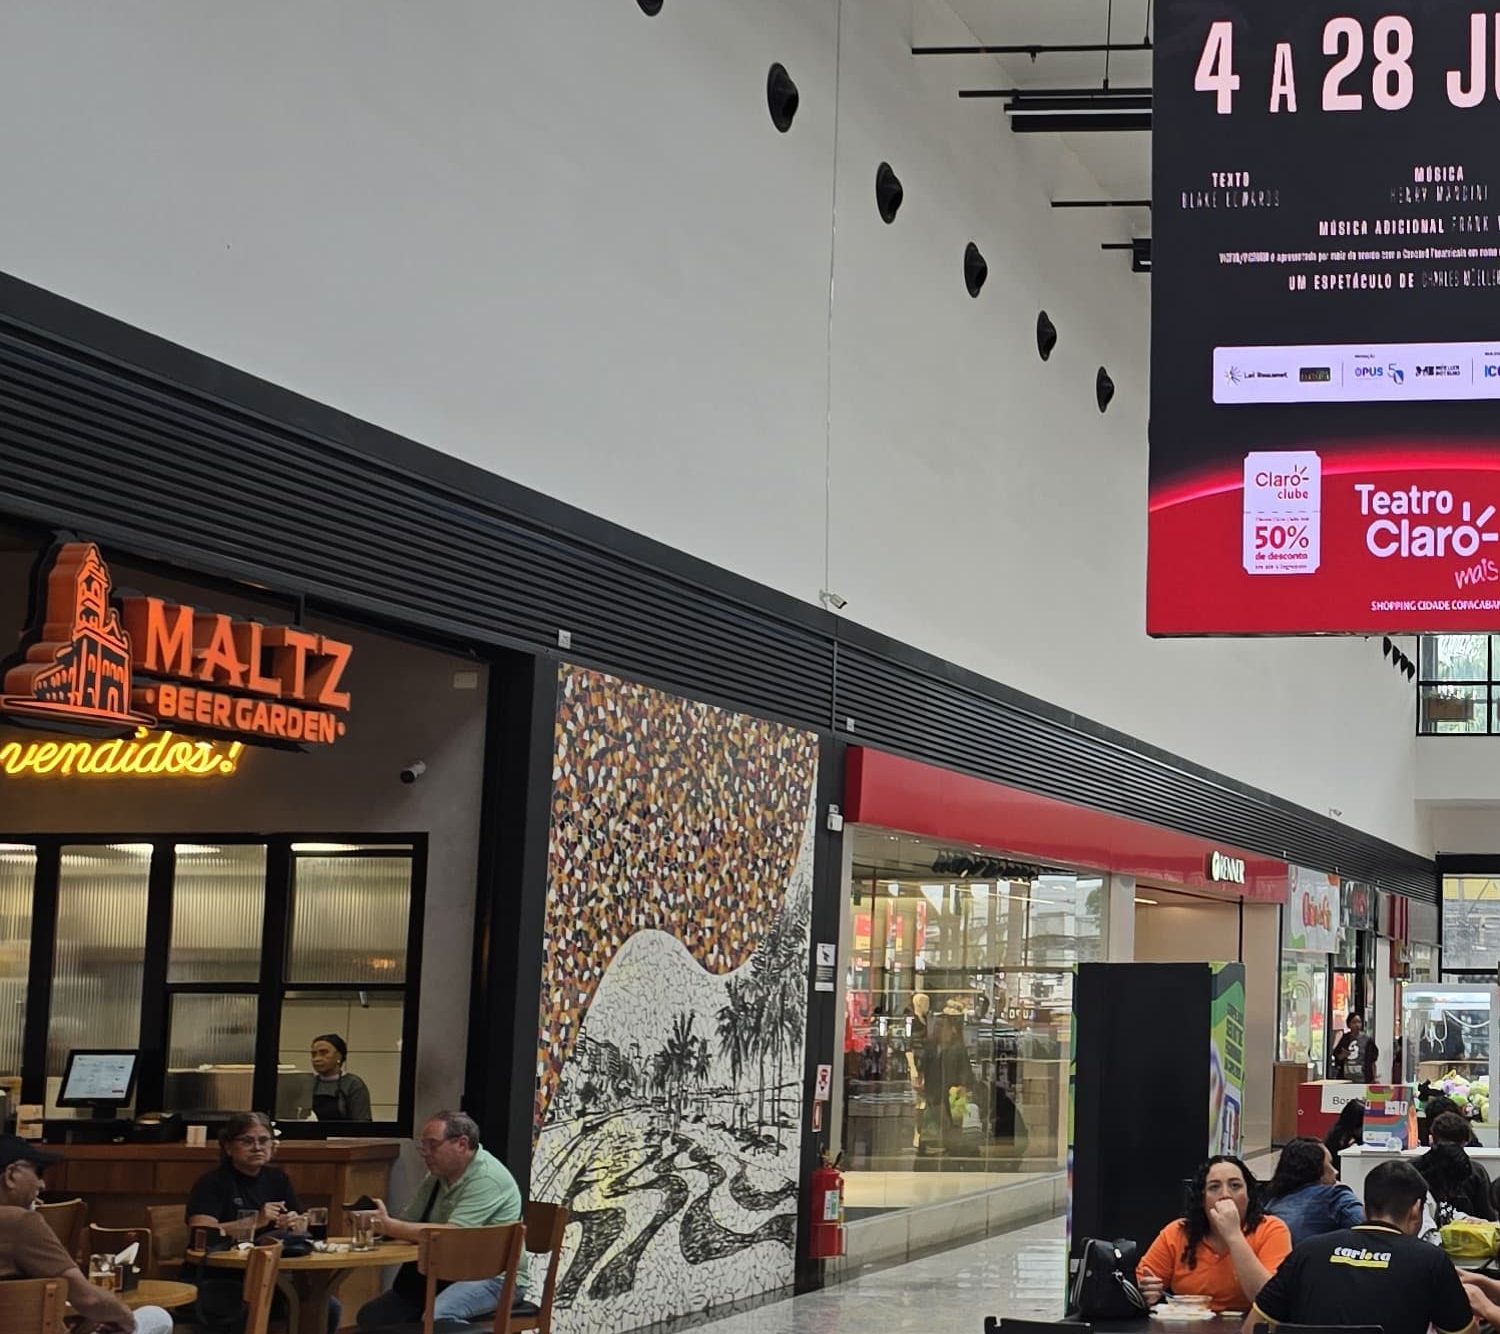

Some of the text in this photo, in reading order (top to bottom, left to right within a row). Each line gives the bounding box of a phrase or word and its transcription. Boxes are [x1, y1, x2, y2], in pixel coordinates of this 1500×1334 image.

[1194, 21, 1240, 114] 4
[1269, 42, 1297, 113] A
[1321, 14, 1414, 112] 28
[1212, 172, 1250, 188] TEXTO
[1414, 165, 1464, 183] MÚSICA
[1319, 220, 1368, 236] MÚSICA
[1375, 218, 1445, 235] ADICIONAL
[1289, 276, 1306, 291] UM
[1314, 272, 1392, 289] ESPETÁCULO
[1400, 273, 1414, 288] DE
[1355, 367, 1383, 377] OPUS
[1256, 468, 1303, 487] Claro
[1278, 488, 1308, 499] clube
[1354, 484, 1453, 515] Teatro
[1255, 525, 1309, 549] 50%
[1367, 514, 1483, 557] Claro
[1455, 558, 1499, 589] mais
[1371, 600, 1416, 611] SHOPPING
[1418, 600, 1450, 610] CIDADE
[145, 597, 353, 711] MALTZ
[158, 684, 336, 744] BEER GARDEN
[1334, 1247, 1392, 1261] carioca
